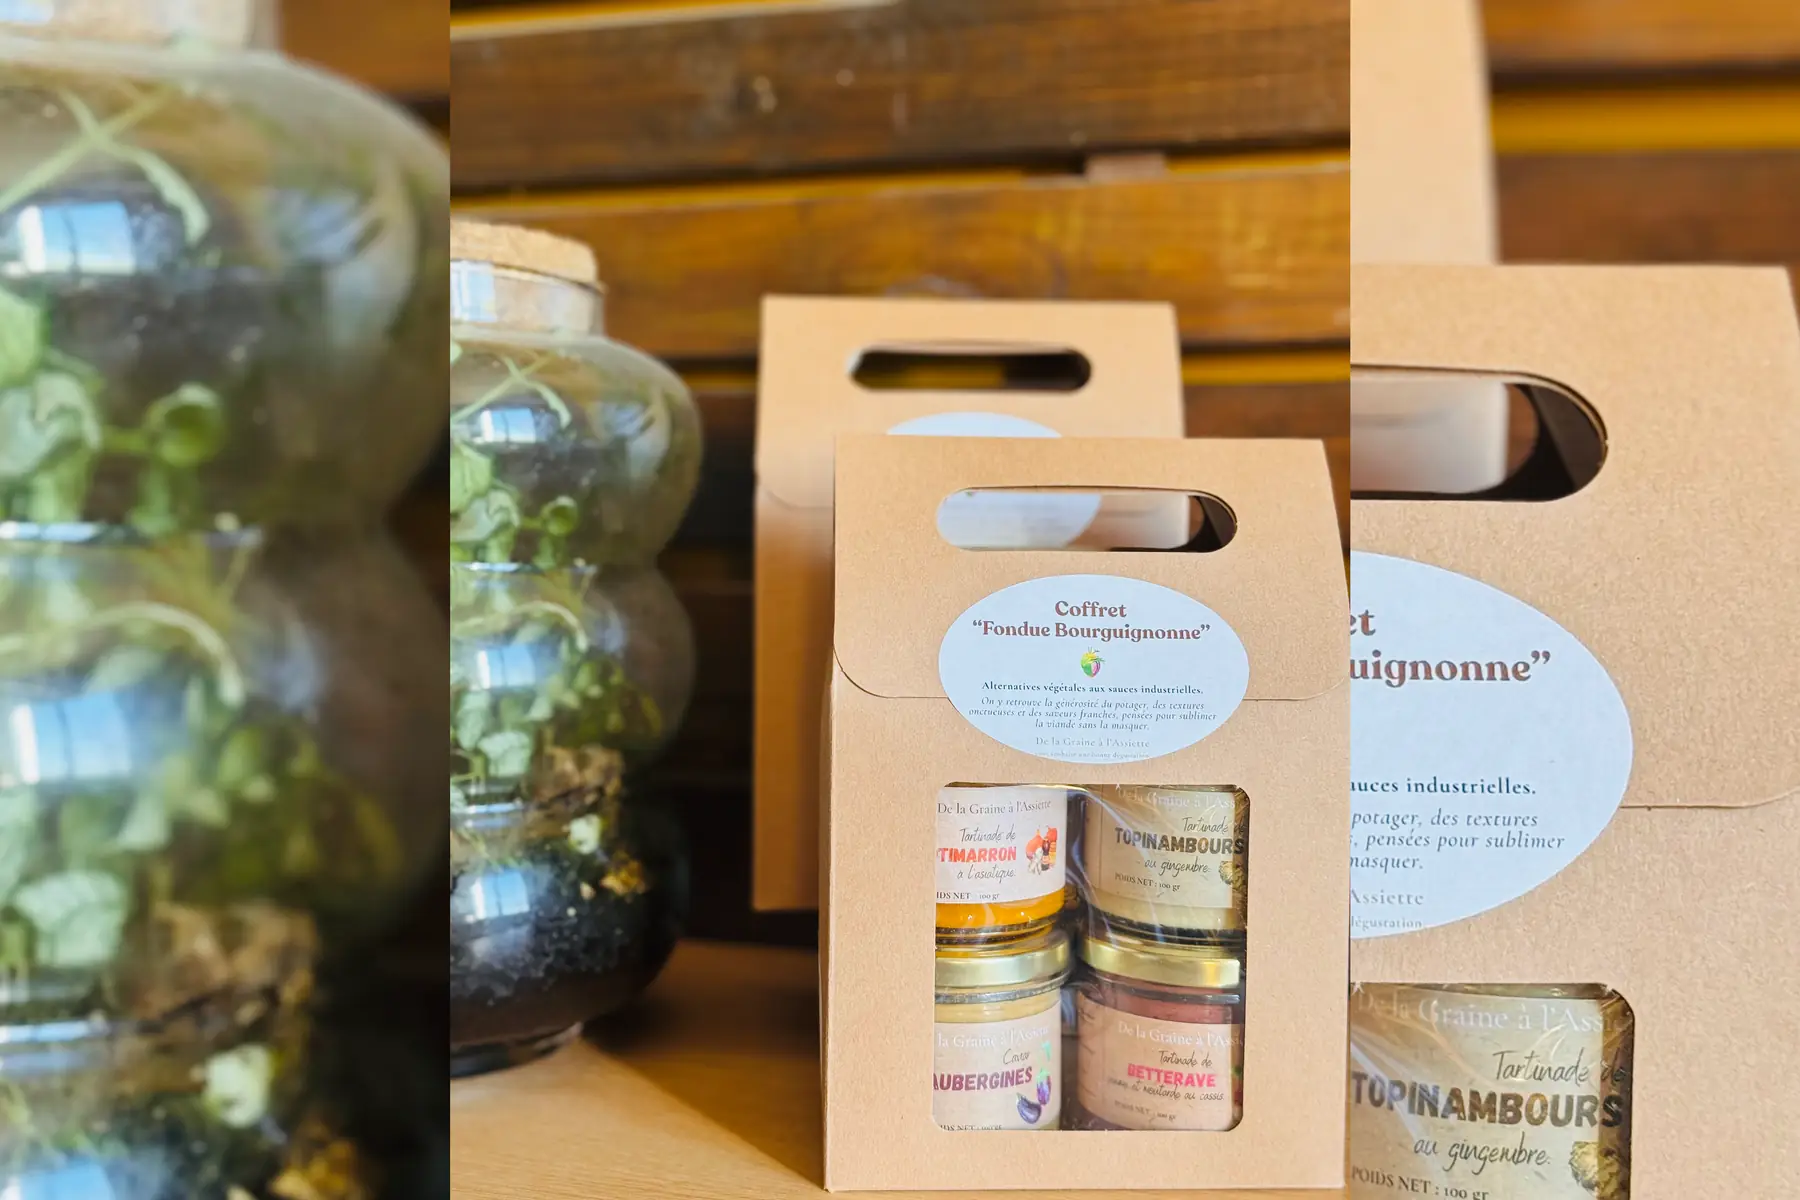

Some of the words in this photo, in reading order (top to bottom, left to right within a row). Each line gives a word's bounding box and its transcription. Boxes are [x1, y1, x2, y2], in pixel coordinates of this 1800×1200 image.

[1055, 600, 1127, 617] Coffret
[972, 619, 1051, 637] “Fondue
[1054, 622, 1211, 643] Bourguignonne”
[981, 681, 1041, 691] Alternatives
[1043, 683, 1086, 694] végétales
[1089, 685, 1106, 693] aux
[1108, 686, 1138, 694] sauces
[1141, 685, 1204, 694] industrielles.
[981, 697, 995, 705] On
[997, 700, 1003, 709] y
[1005, 698, 1042, 707] retrouve
[1044, 698, 1053, 707] la
[1055, 698, 1099, 709] générosité
[1101, 699, 1112, 708] du
[1114, 701, 1149, 711] potager,
[1152, 700, 1166, 709] des
[1169, 702, 1205, 710] textures
[968, 708, 1015, 716] onctueuses
[1028, 708, 1042, 717] des
[1044, 710, 1077, 718] saveurs
[1078, 709, 1119, 720] franches,
[1121, 709, 1153, 720] pensées
[1155, 712, 1177, 721] pour
[1178, 710, 1217, 720] sublimer
[1035, 719, 1044, 728] la
[1046, 719, 1076, 729] viande
[1099, 720, 1108, 729] la
[1111, 722, 1150, 732] masquer.
[1036, 737, 1049, 745] De
[1052, 737, 1060, 746] la
[1063, 738, 1096, 747] Graine
[1406, 776, 1536, 795] industrielles.
[937, 802, 953, 814] De
[956, 802, 966, 814] la
[969, 803, 1006, 814] Graine
[1008, 802, 1014, 813] à
[1016, 800, 1052, 813] l'Assiette
[1181, 815, 1229, 835] Tartinade
[1351, 812, 1422, 831] potager,
[1430, 808, 1459, 826] des
[1466, 813, 1539, 827] textures
[1005, 823, 1016, 842] de
[1114, 826, 1245, 855] TOPINAMBOURS
[1365, 828, 1430, 851] pensées
[1437, 835, 1480, 852] pour
[1485, 831, 1565, 849] sublimer
[1144, 859, 1157, 869] au
[1115, 872, 1136, 884] POIDS
[1137, 877, 1154, 887] NET
[1172, 884, 1181, 892] gr
[1418, 998, 1508, 1031] Graine
[1518, 1002, 1532, 1030] à
[937, 1032, 949, 1048] la
[952, 1034, 997, 1048] Graine
[1118, 1021, 1134, 1036] De
[1136, 1023, 1146, 1040] la
[1149, 1028, 1193, 1045] Graine
[1200, 1052, 1213, 1067] de
[1491, 1046, 1590, 1087] Tartinade
[1127, 1063, 1218, 1088] BETTERAVE
[1184, 1091, 1196, 1100] au
[1351, 1070, 1624, 1128] TOPINAMBOURS
[1413, 1136, 1438, 1157] au
[1351, 1165, 1394, 1188] POIDS
[1398, 1175, 1432, 1195] NET
[1444, 1187, 1467, 1199] 100
